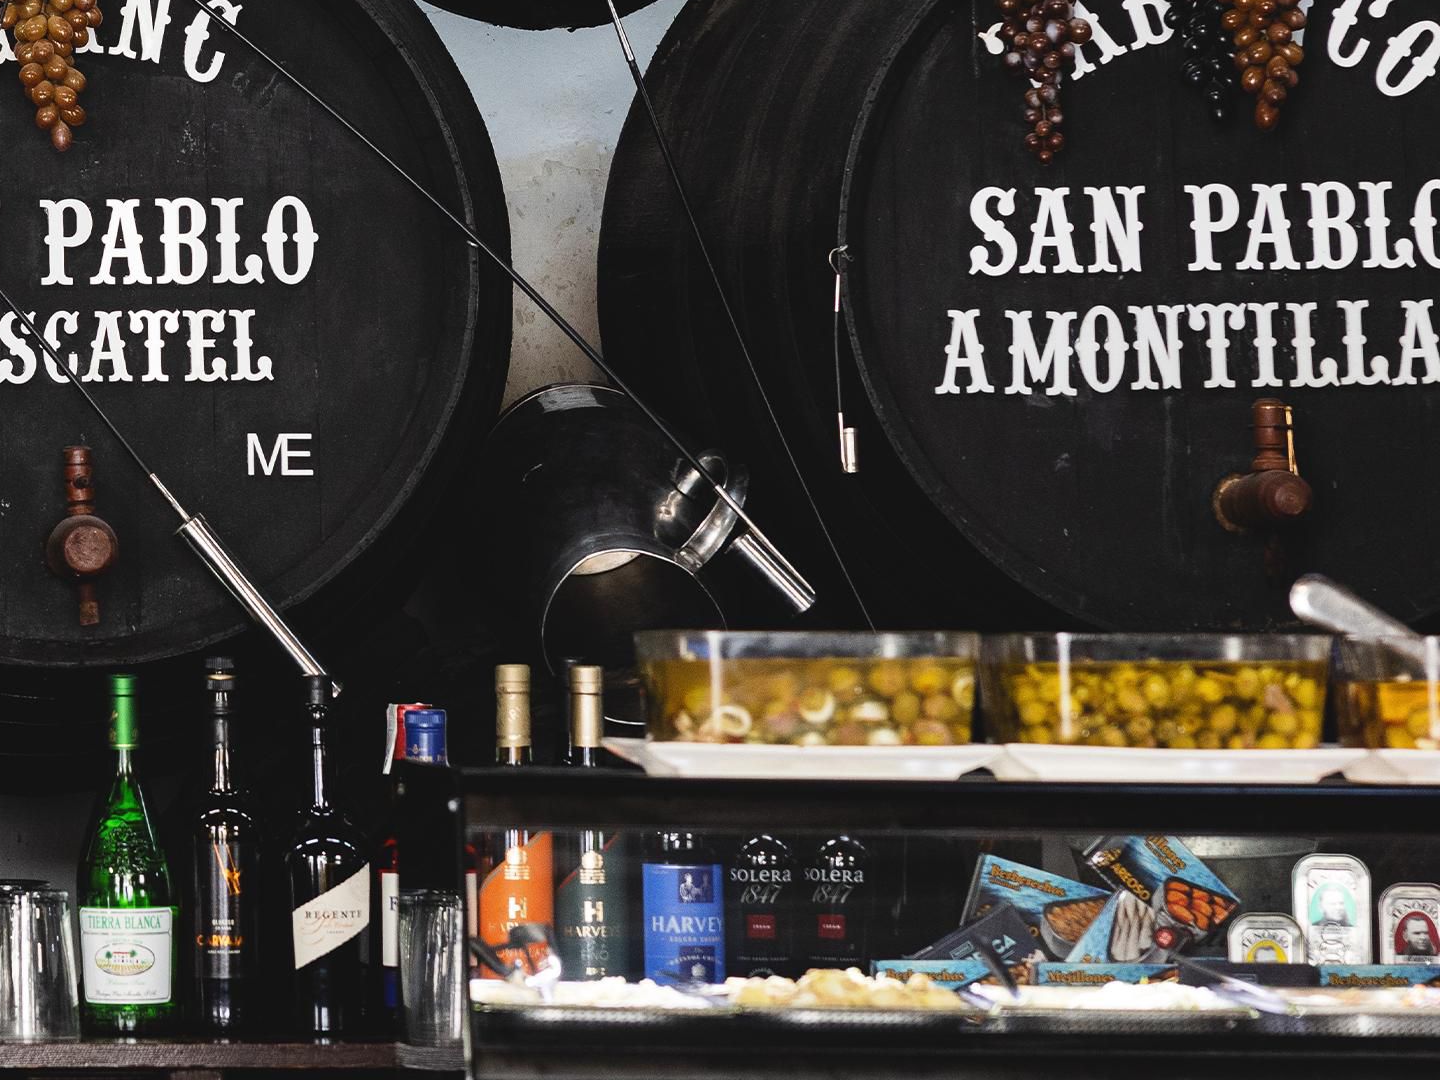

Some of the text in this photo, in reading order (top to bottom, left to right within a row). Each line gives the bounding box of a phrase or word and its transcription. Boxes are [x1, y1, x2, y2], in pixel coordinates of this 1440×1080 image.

[39, 195, 320, 286] PABLO
[968, 185, 1146, 277] SAN
[246, 432, 314, 476] ME
[740, 883, 782, 903] 1847
[812, 883, 854, 903] 1847
[88, 915, 162, 929] TIERRA BLANCA
